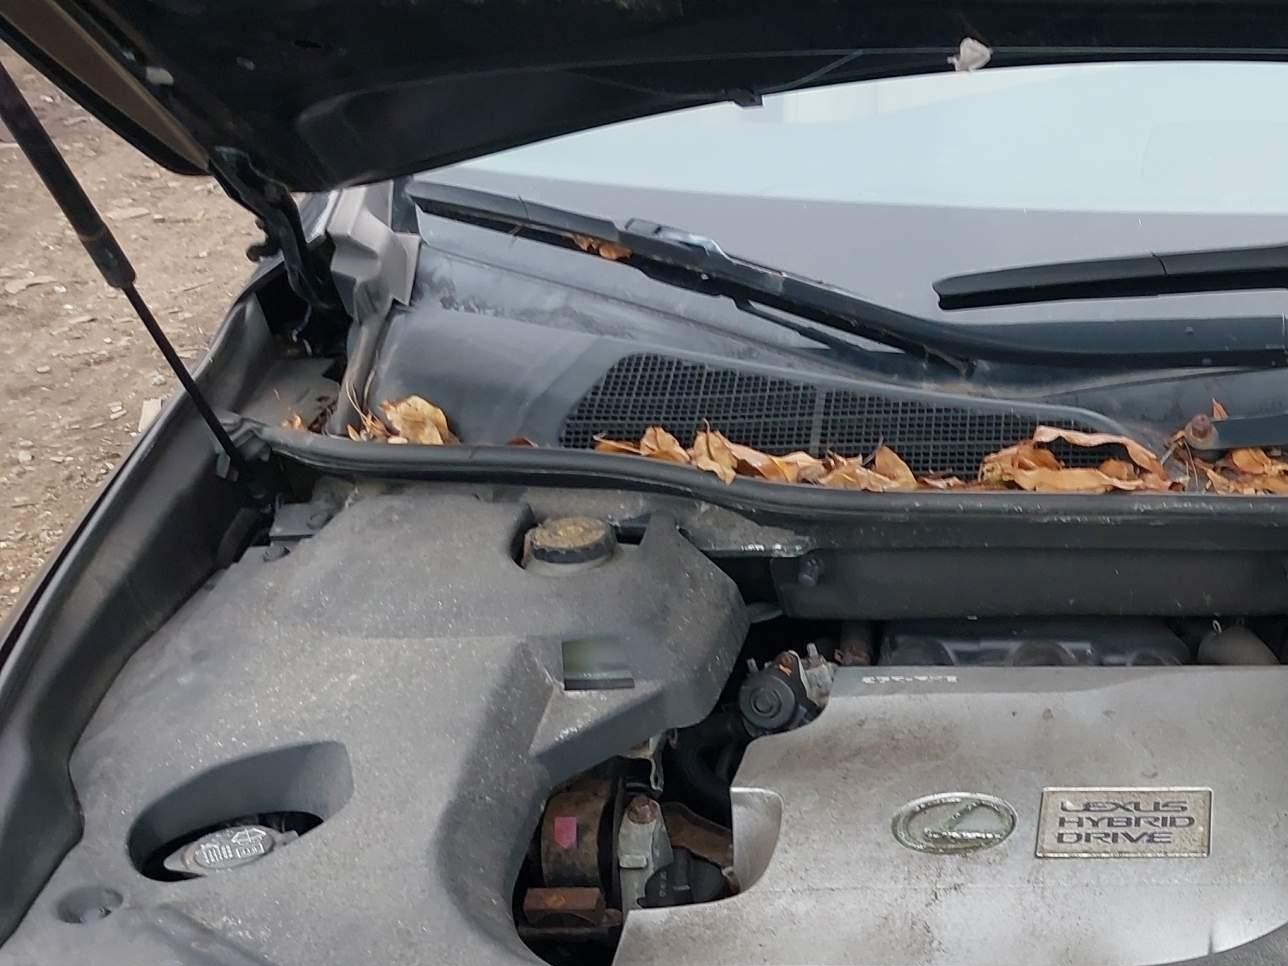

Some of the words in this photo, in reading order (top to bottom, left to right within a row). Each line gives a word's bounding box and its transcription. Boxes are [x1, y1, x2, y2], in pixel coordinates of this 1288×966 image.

[1060, 801, 1188, 813] LEXUS
[1058, 816, 1196, 829] HYBRID
[1056, 832, 1174, 844] DRIVE
